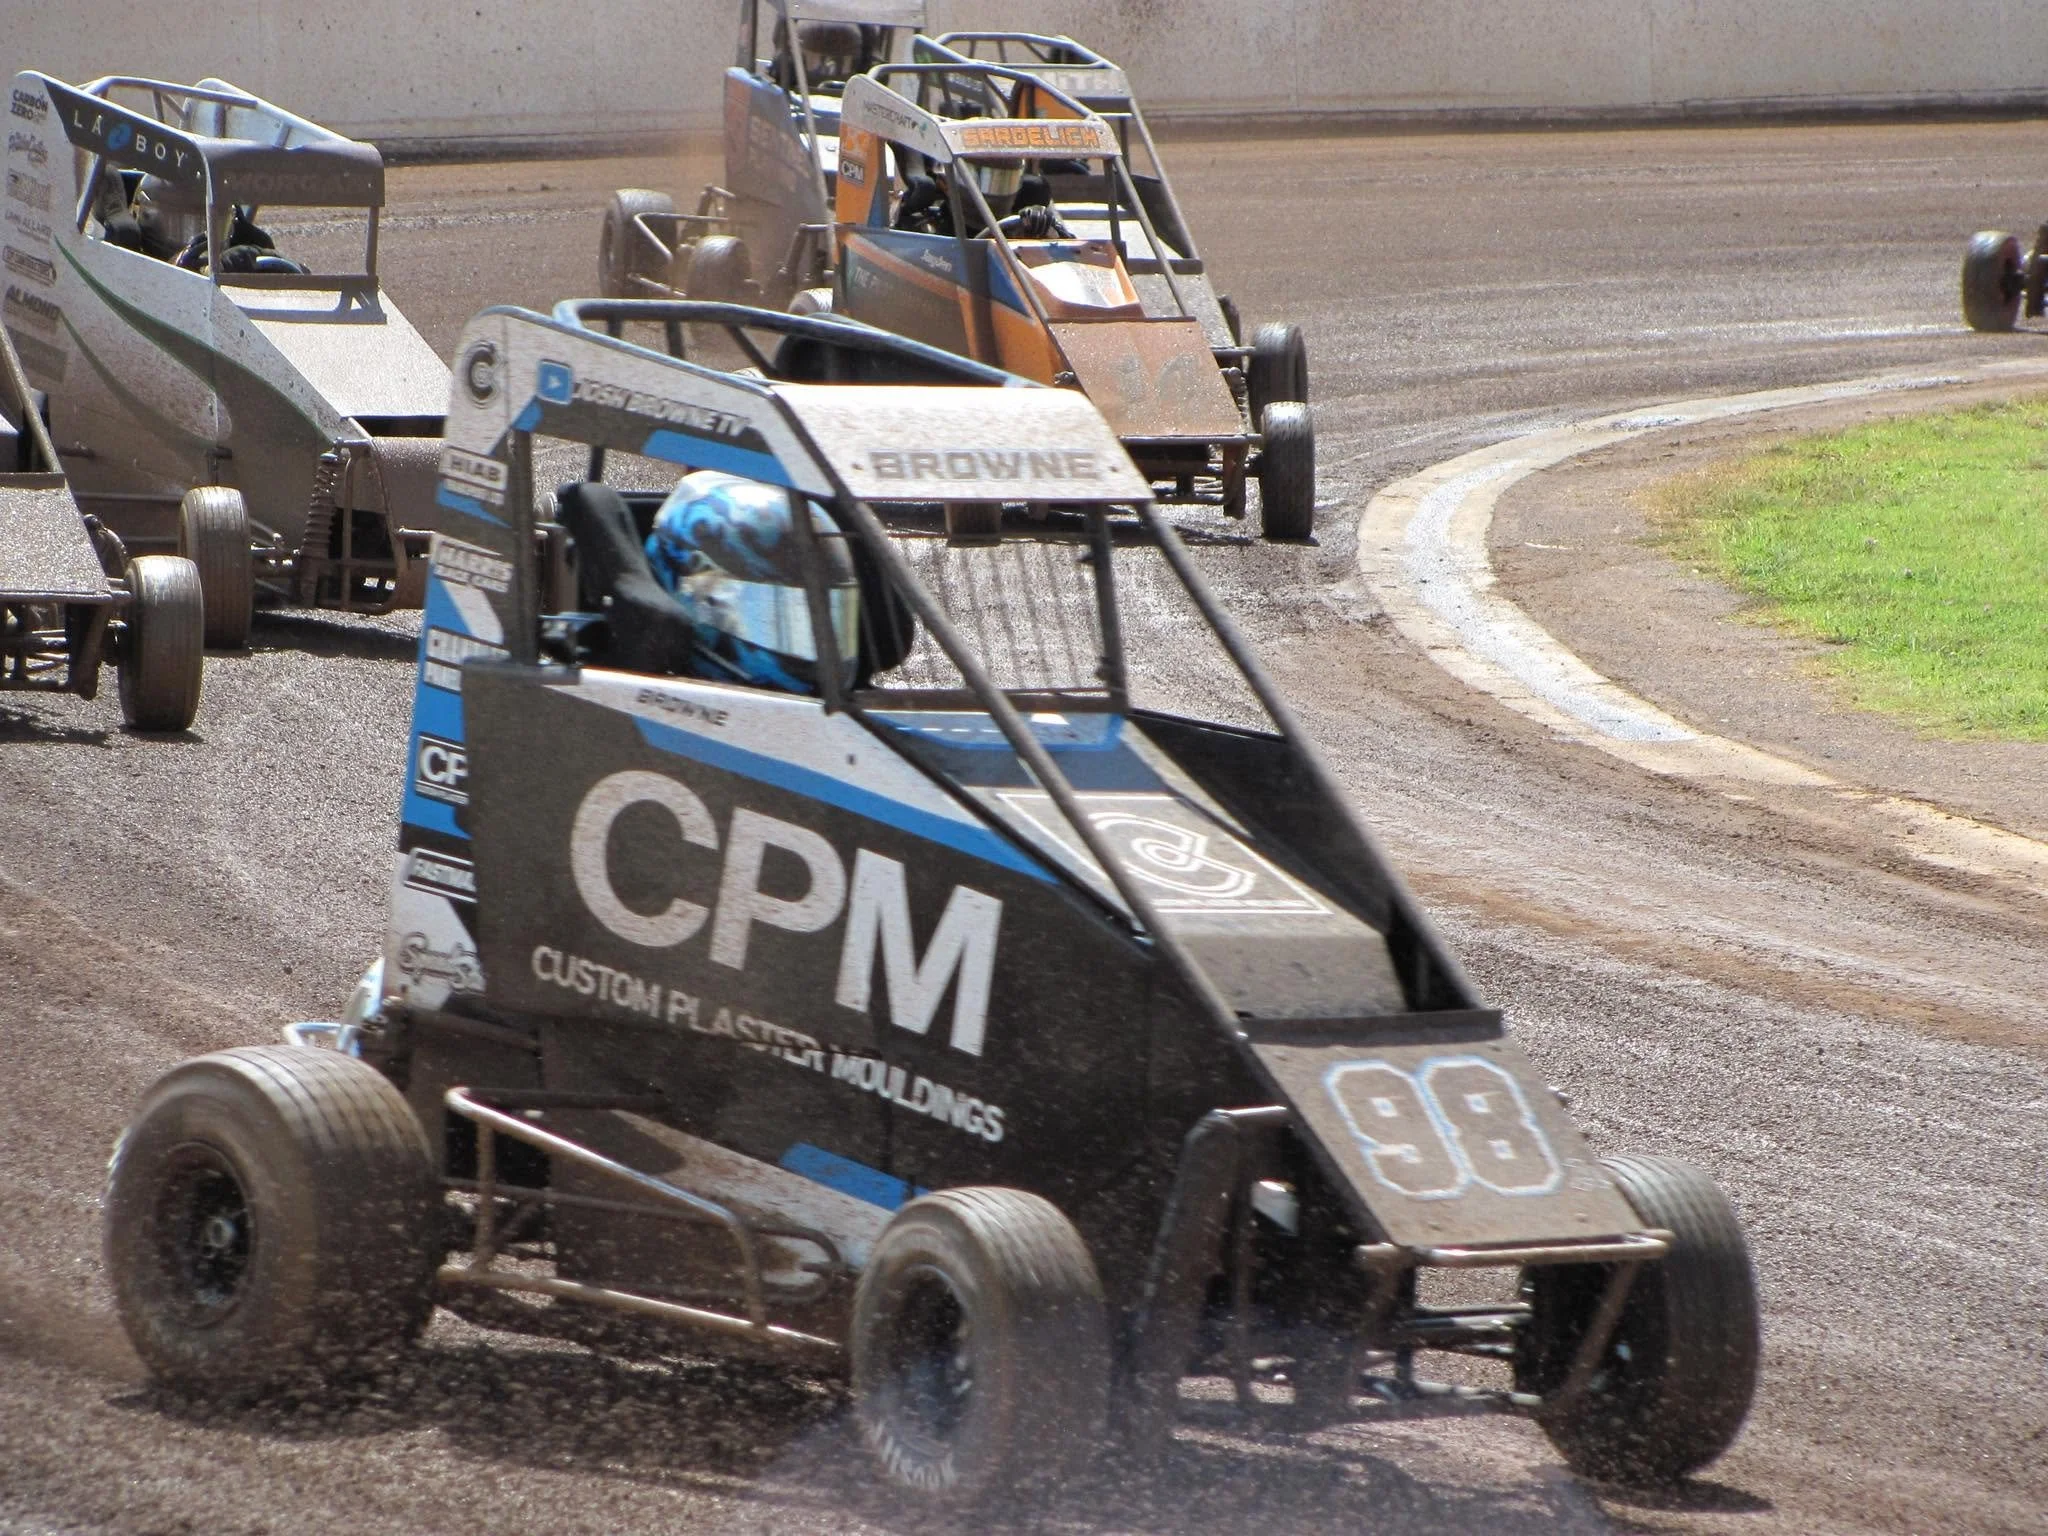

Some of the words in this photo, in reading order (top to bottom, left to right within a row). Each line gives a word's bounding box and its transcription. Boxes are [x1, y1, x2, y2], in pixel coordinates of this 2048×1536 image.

[10, 102, 34, 121] ZERO
[12, 88, 48, 113] CARBON
[135, 134, 188, 168] BOY
[962, 126, 1100, 149] SARDELICH
[841, 161, 864, 182] CPM
[5, 284, 61, 321] ALMOND
[625, 390, 718, 431] BROWNE
[715, 412, 750, 438] TV
[868, 450, 1101, 480] BROWNE
[638, 688, 729, 727] BROWNE
[570, 769, 1003, 1057] CPM
[531, 945, 661, 1018] CUSTOM
[667, 990, 825, 1073] PLASTER
[831, 1045, 1005, 1143] MOULDINGS
[1320, 1055, 1566, 1200] 98
